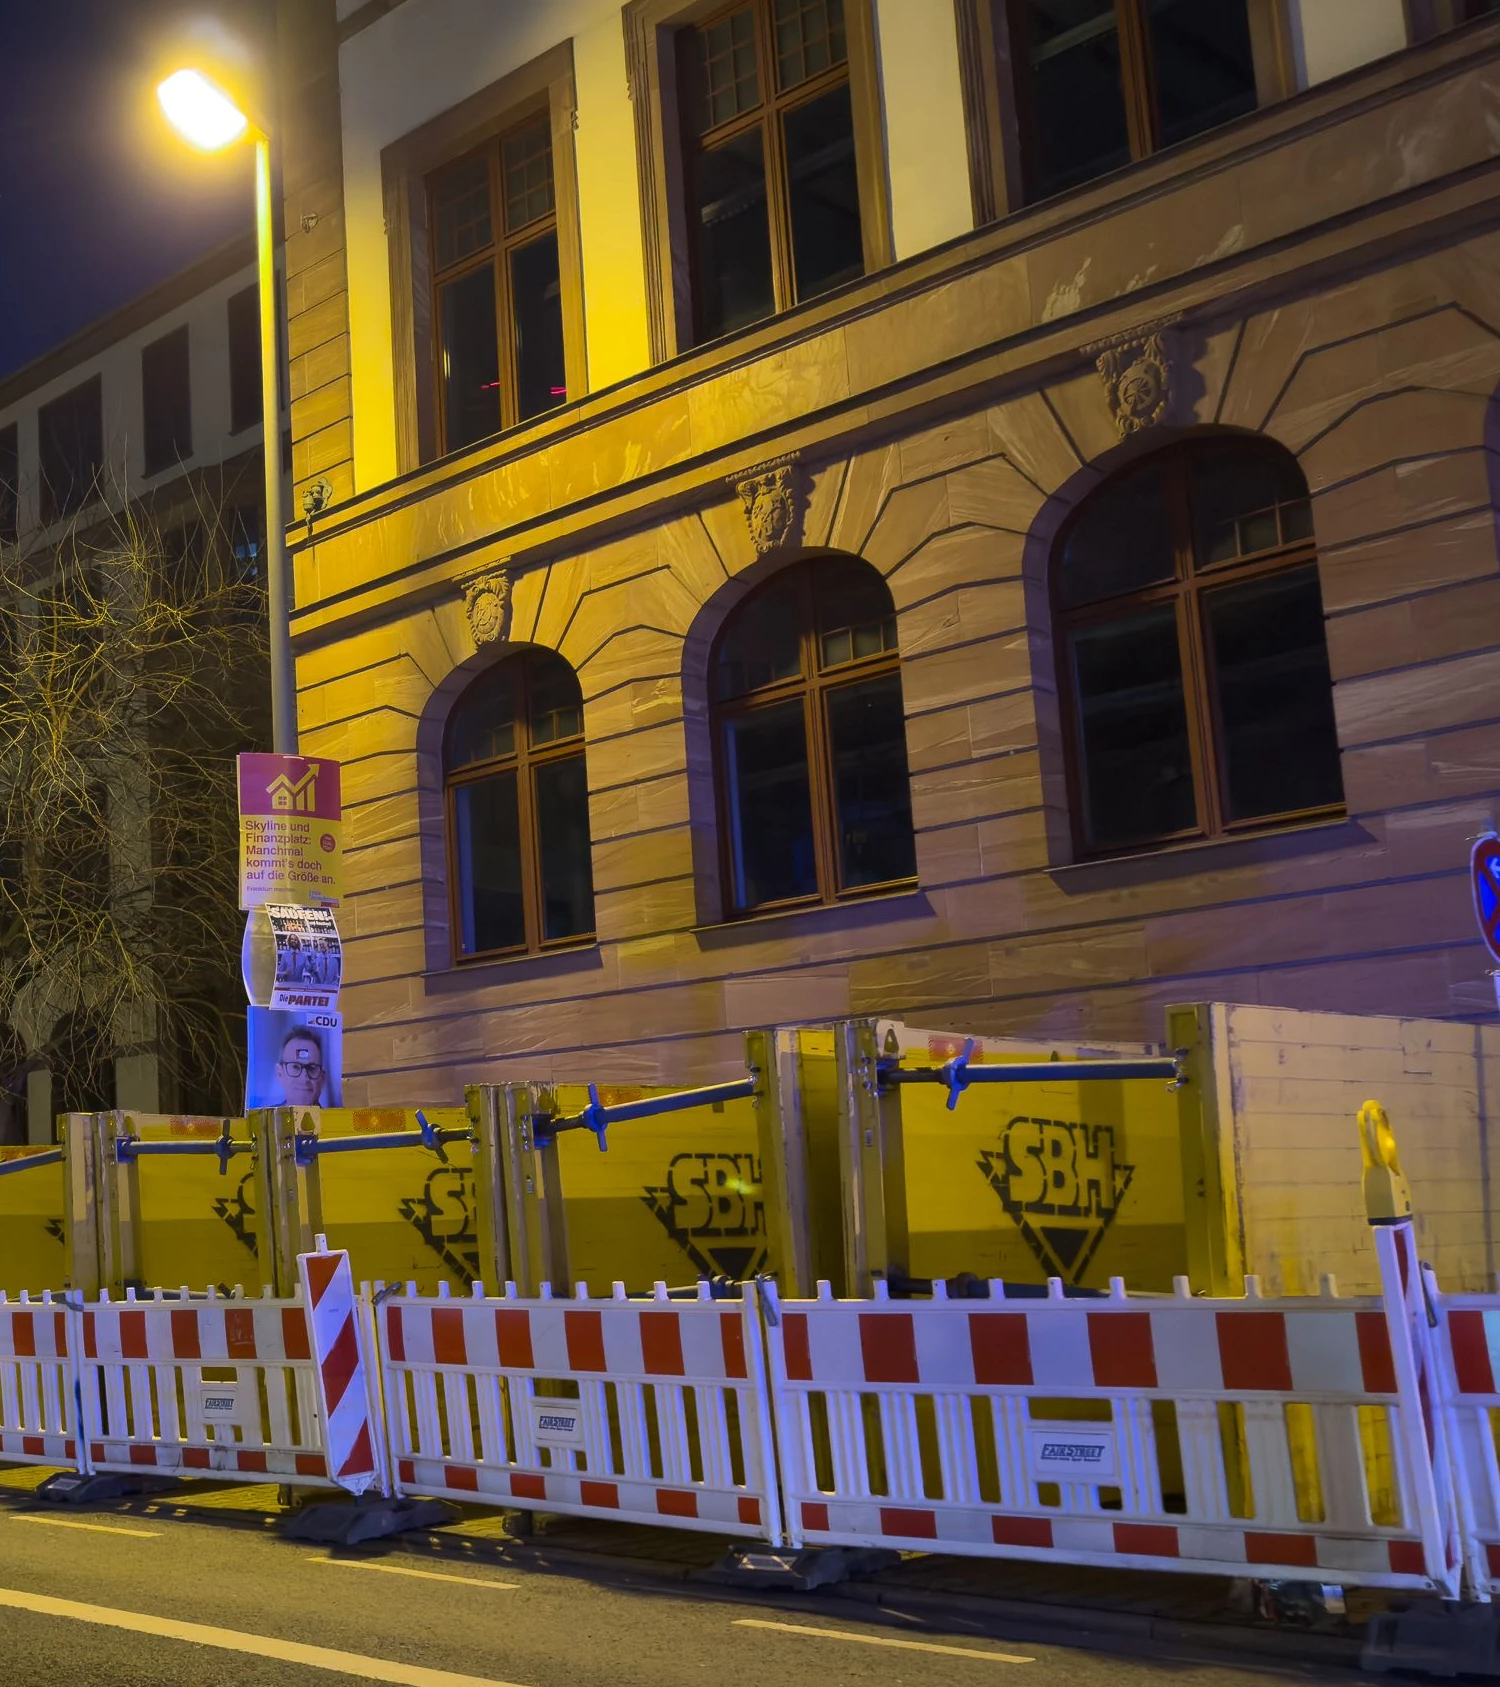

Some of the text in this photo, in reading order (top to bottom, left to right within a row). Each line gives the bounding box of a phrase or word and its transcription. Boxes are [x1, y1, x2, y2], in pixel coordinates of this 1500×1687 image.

[245, 820, 310, 832] Skyline und
[246, 833, 312, 845] Finanzplatz:
[246, 845, 303, 857] Manchmal
[246, 858, 322, 871] kommt's doch
[246, 870, 336, 885] auf die Größe an.
[279, 993, 330, 1007] Die PARTEI
[315, 1016, 338, 1027] CDU
[1003, 1116, 1116, 1217] SBH
